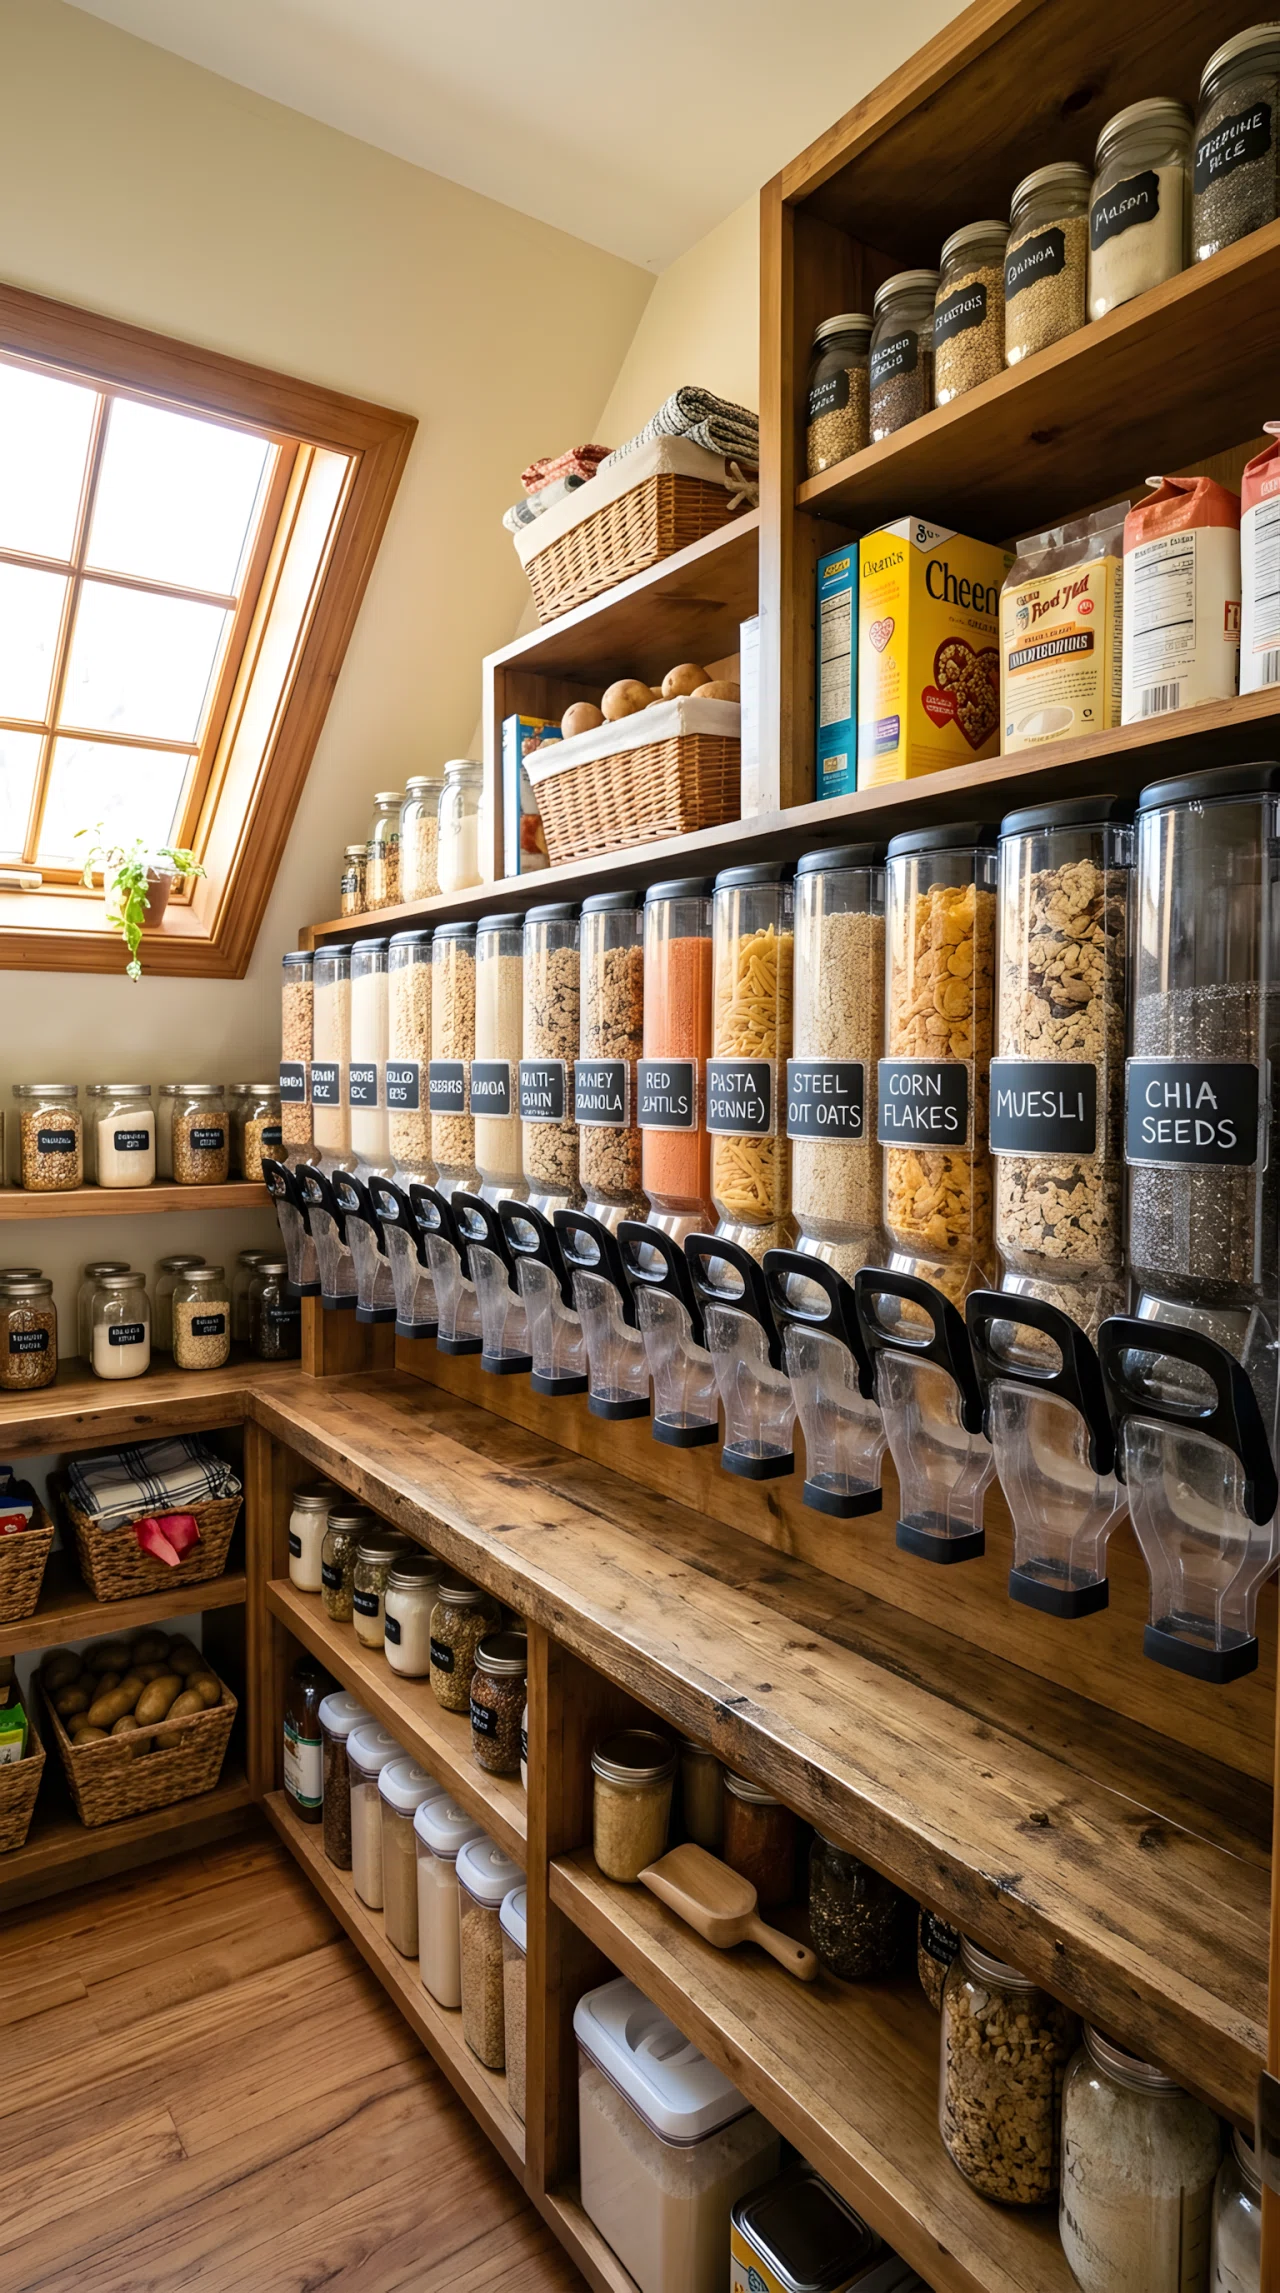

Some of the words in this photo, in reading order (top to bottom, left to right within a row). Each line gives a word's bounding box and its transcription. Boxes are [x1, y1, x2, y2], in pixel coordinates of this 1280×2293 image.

[646, 1072, 670, 1089] RED
[710, 1072, 757, 1093] PASTA
[792, 1073, 849, 1094] STEEL
[889, 1073, 942, 1096] CORN
[997, 1089, 1084, 1122] MUESLI
[1145, 1080, 1218, 1110] CHIA
[816, 1104, 861, 1128] OATS
[884, 1103, 958, 1131] FLAKES
[1141, 1116, 1237, 1149] SEEDS
